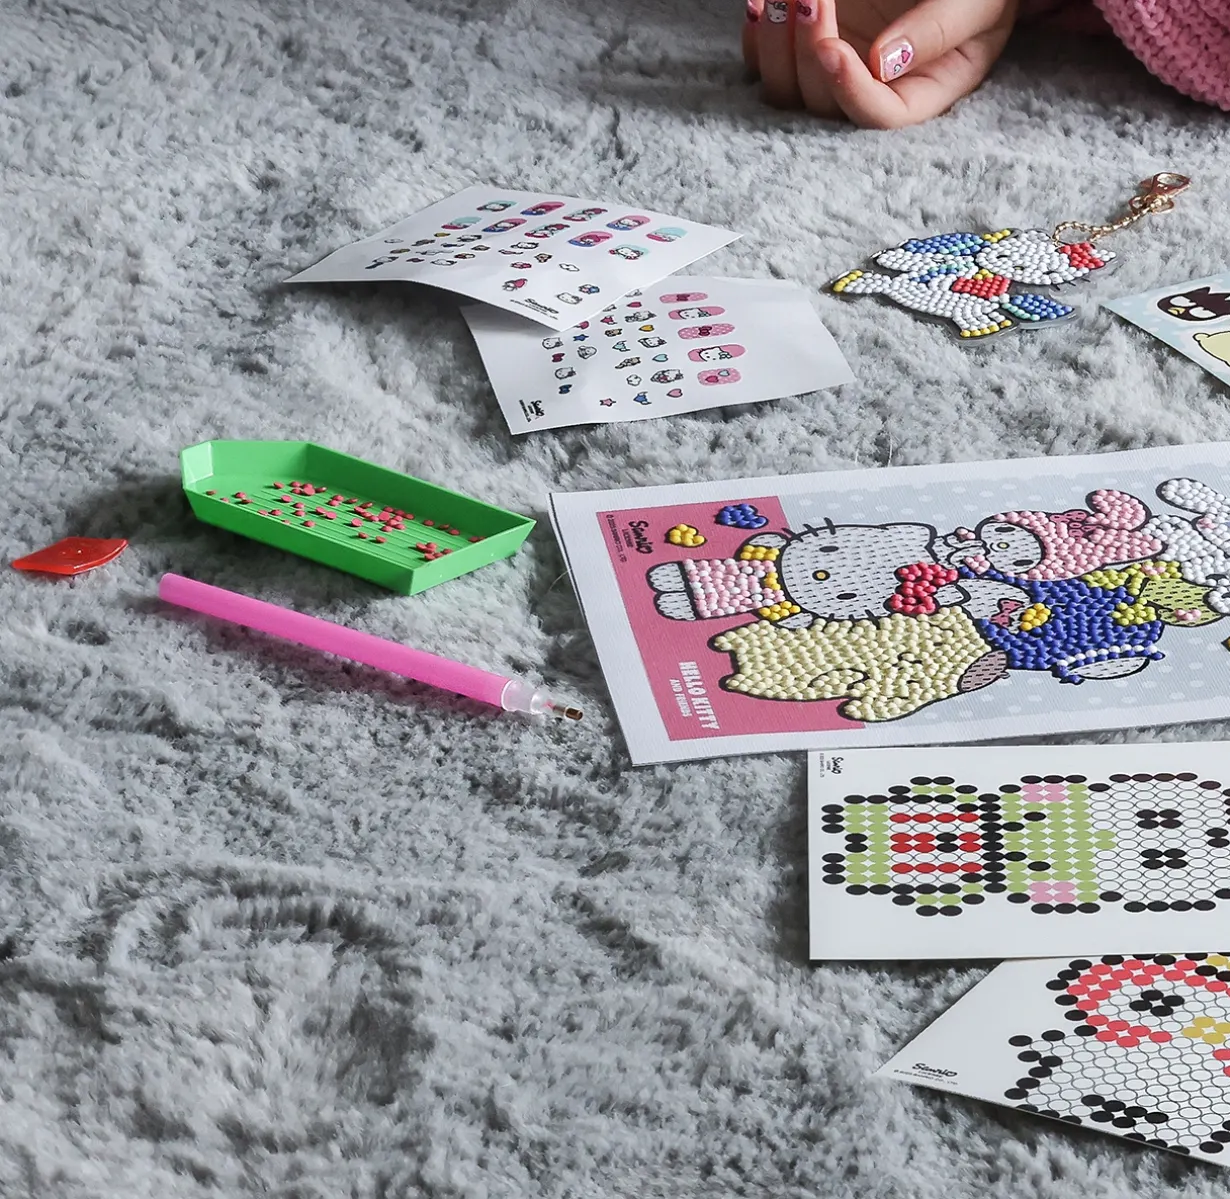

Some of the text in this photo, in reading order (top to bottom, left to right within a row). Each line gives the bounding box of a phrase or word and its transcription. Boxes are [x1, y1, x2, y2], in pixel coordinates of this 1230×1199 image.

[628, 520, 654, 554] Sanrio
[669, 678, 693, 717] AND FRIENDS
[678, 661, 720, 730] HELLO KITTY
[912, 1062, 958, 1078] Sanrio
